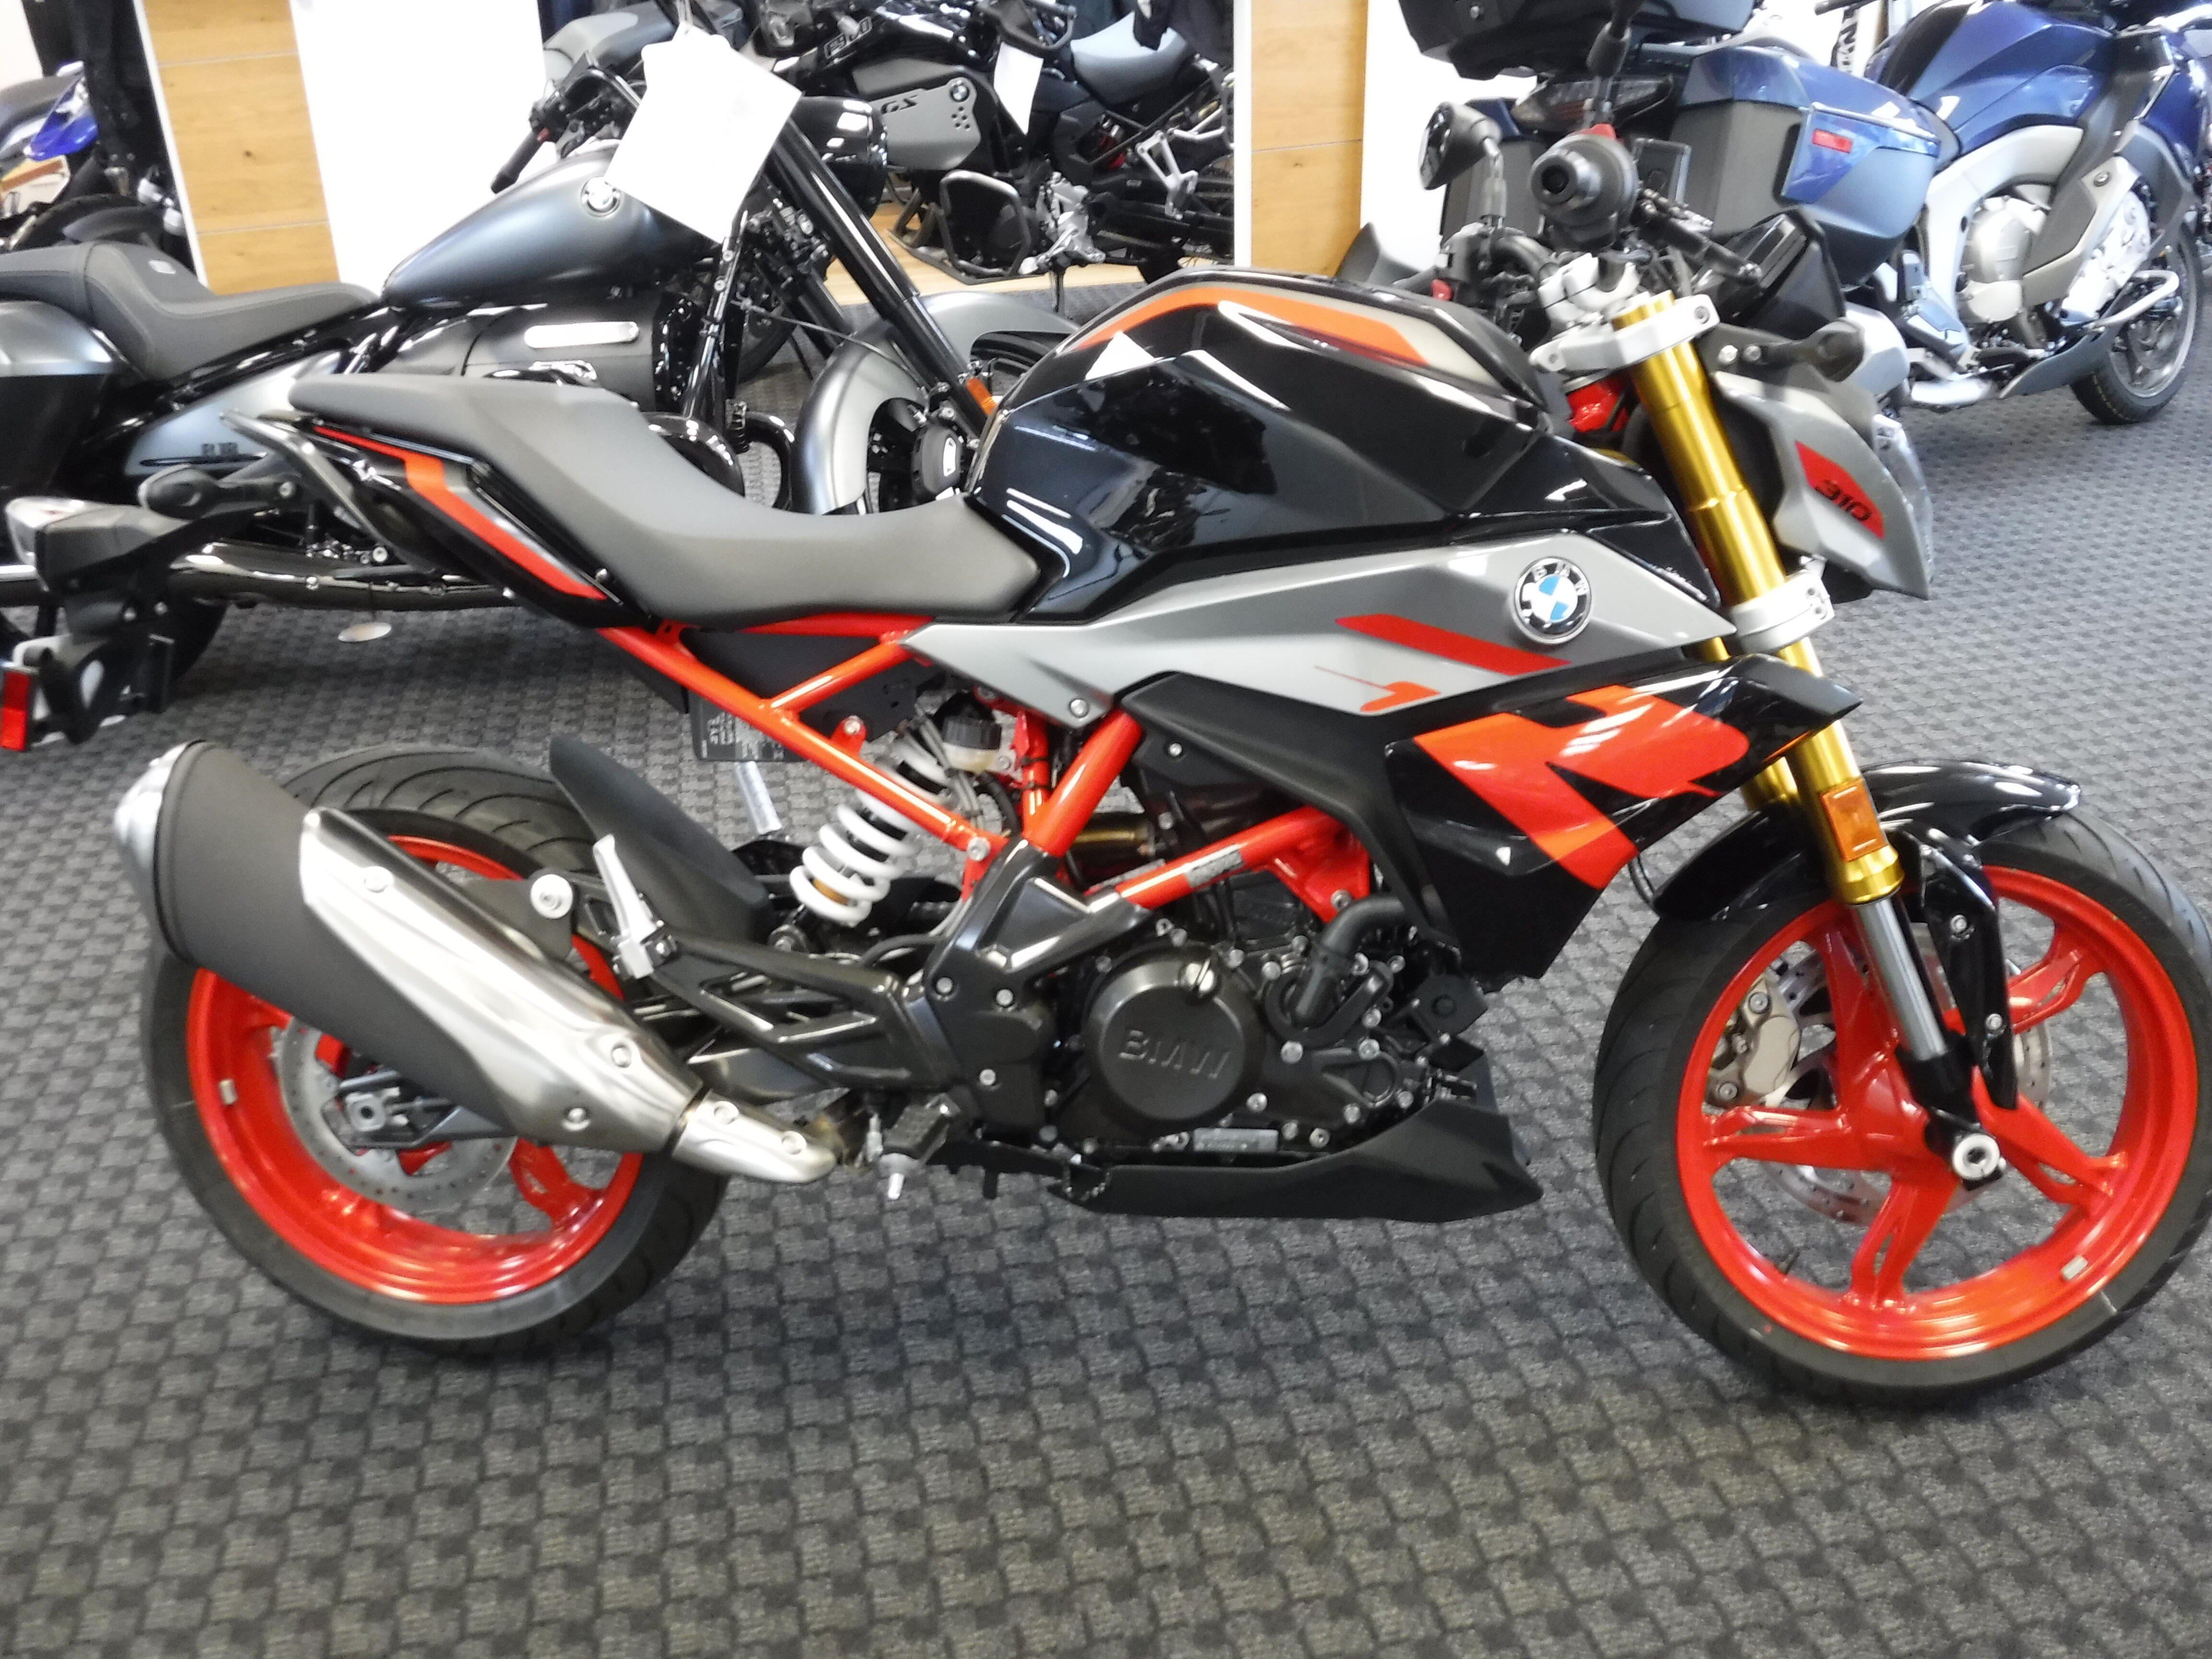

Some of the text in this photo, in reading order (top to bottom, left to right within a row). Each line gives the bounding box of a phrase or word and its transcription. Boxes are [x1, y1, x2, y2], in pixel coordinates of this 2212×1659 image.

[1814, 480, 1872, 521] 310
[1530, 561, 1587, 596] BMW
[1118, 1029, 1229, 1079] BMW
